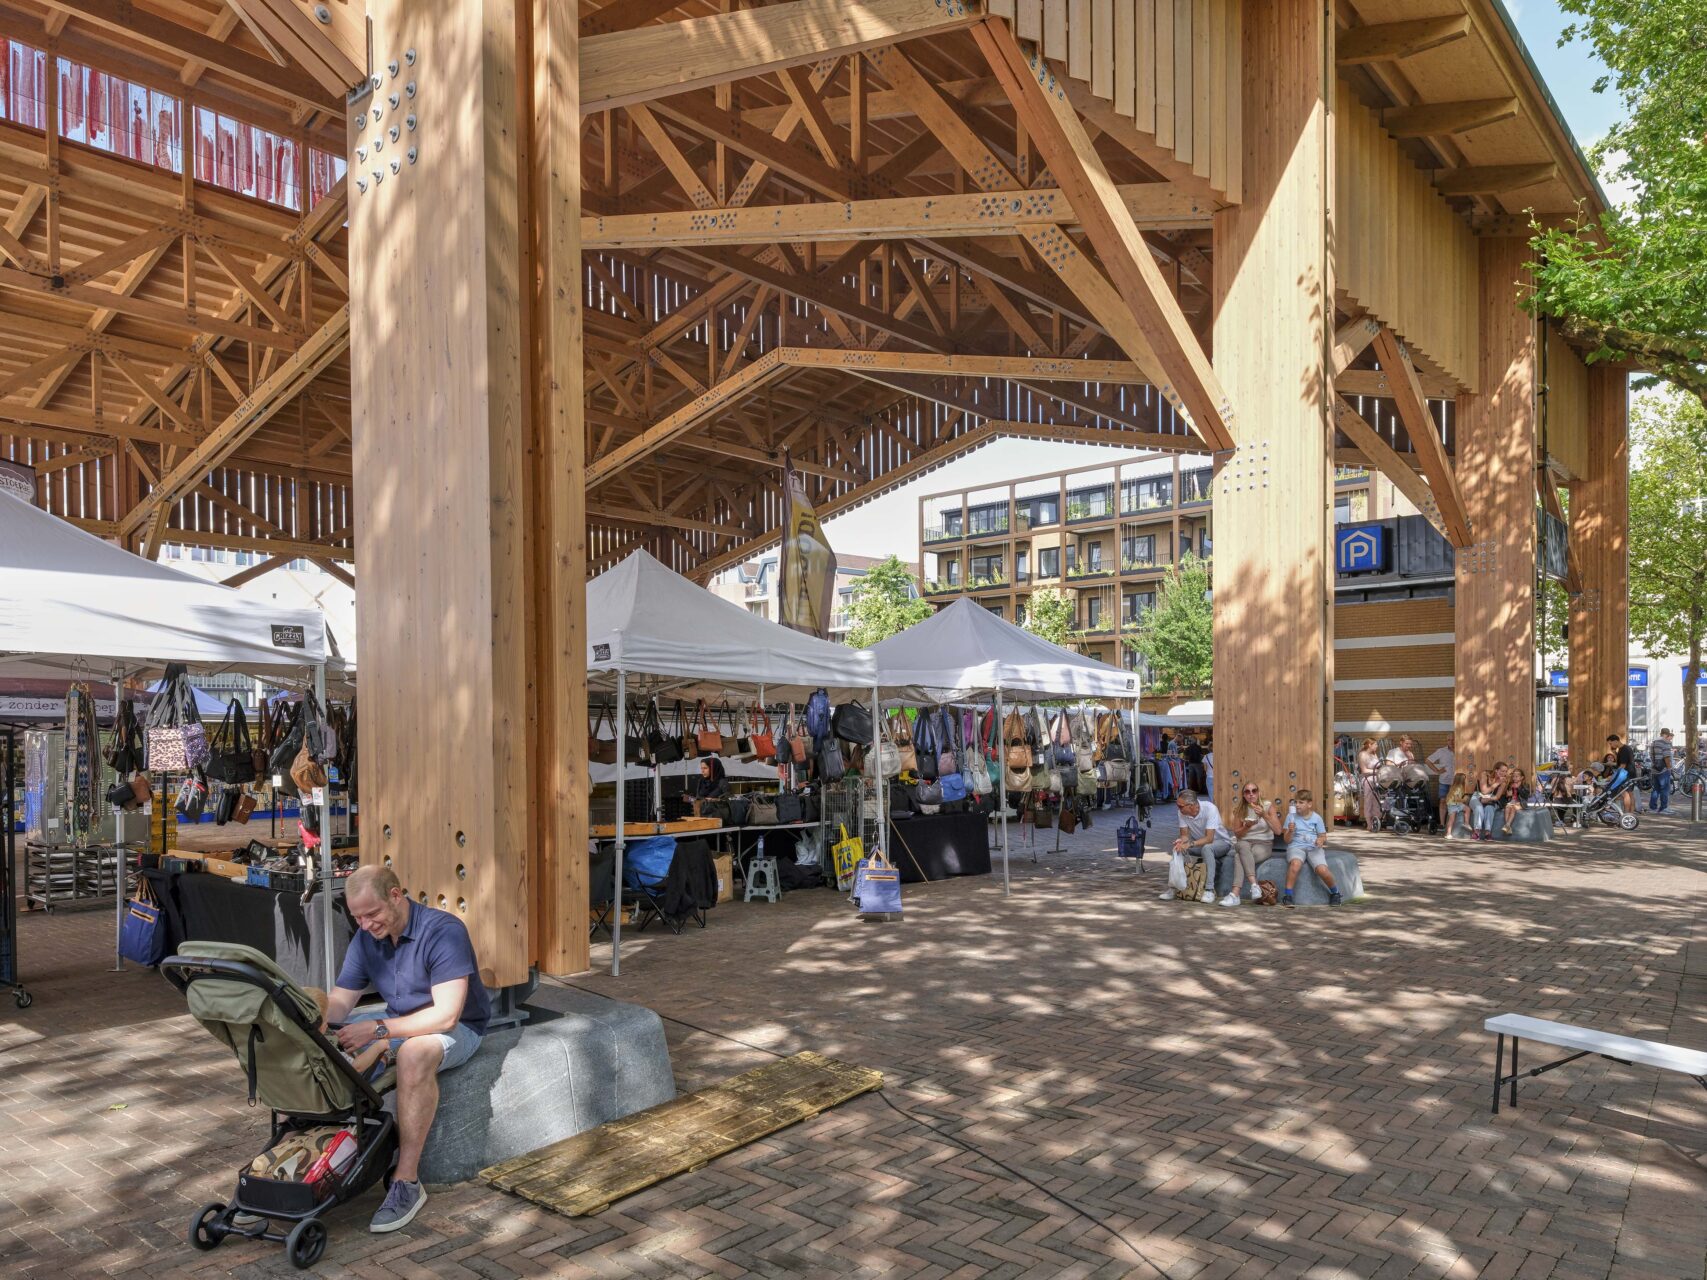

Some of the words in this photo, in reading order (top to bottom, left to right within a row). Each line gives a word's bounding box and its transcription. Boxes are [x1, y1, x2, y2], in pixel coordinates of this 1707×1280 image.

[1350, 541, 1369, 567] P
[273, 632, 302, 642] GRIZZLY
[9, 701, 59, 710] zonder
